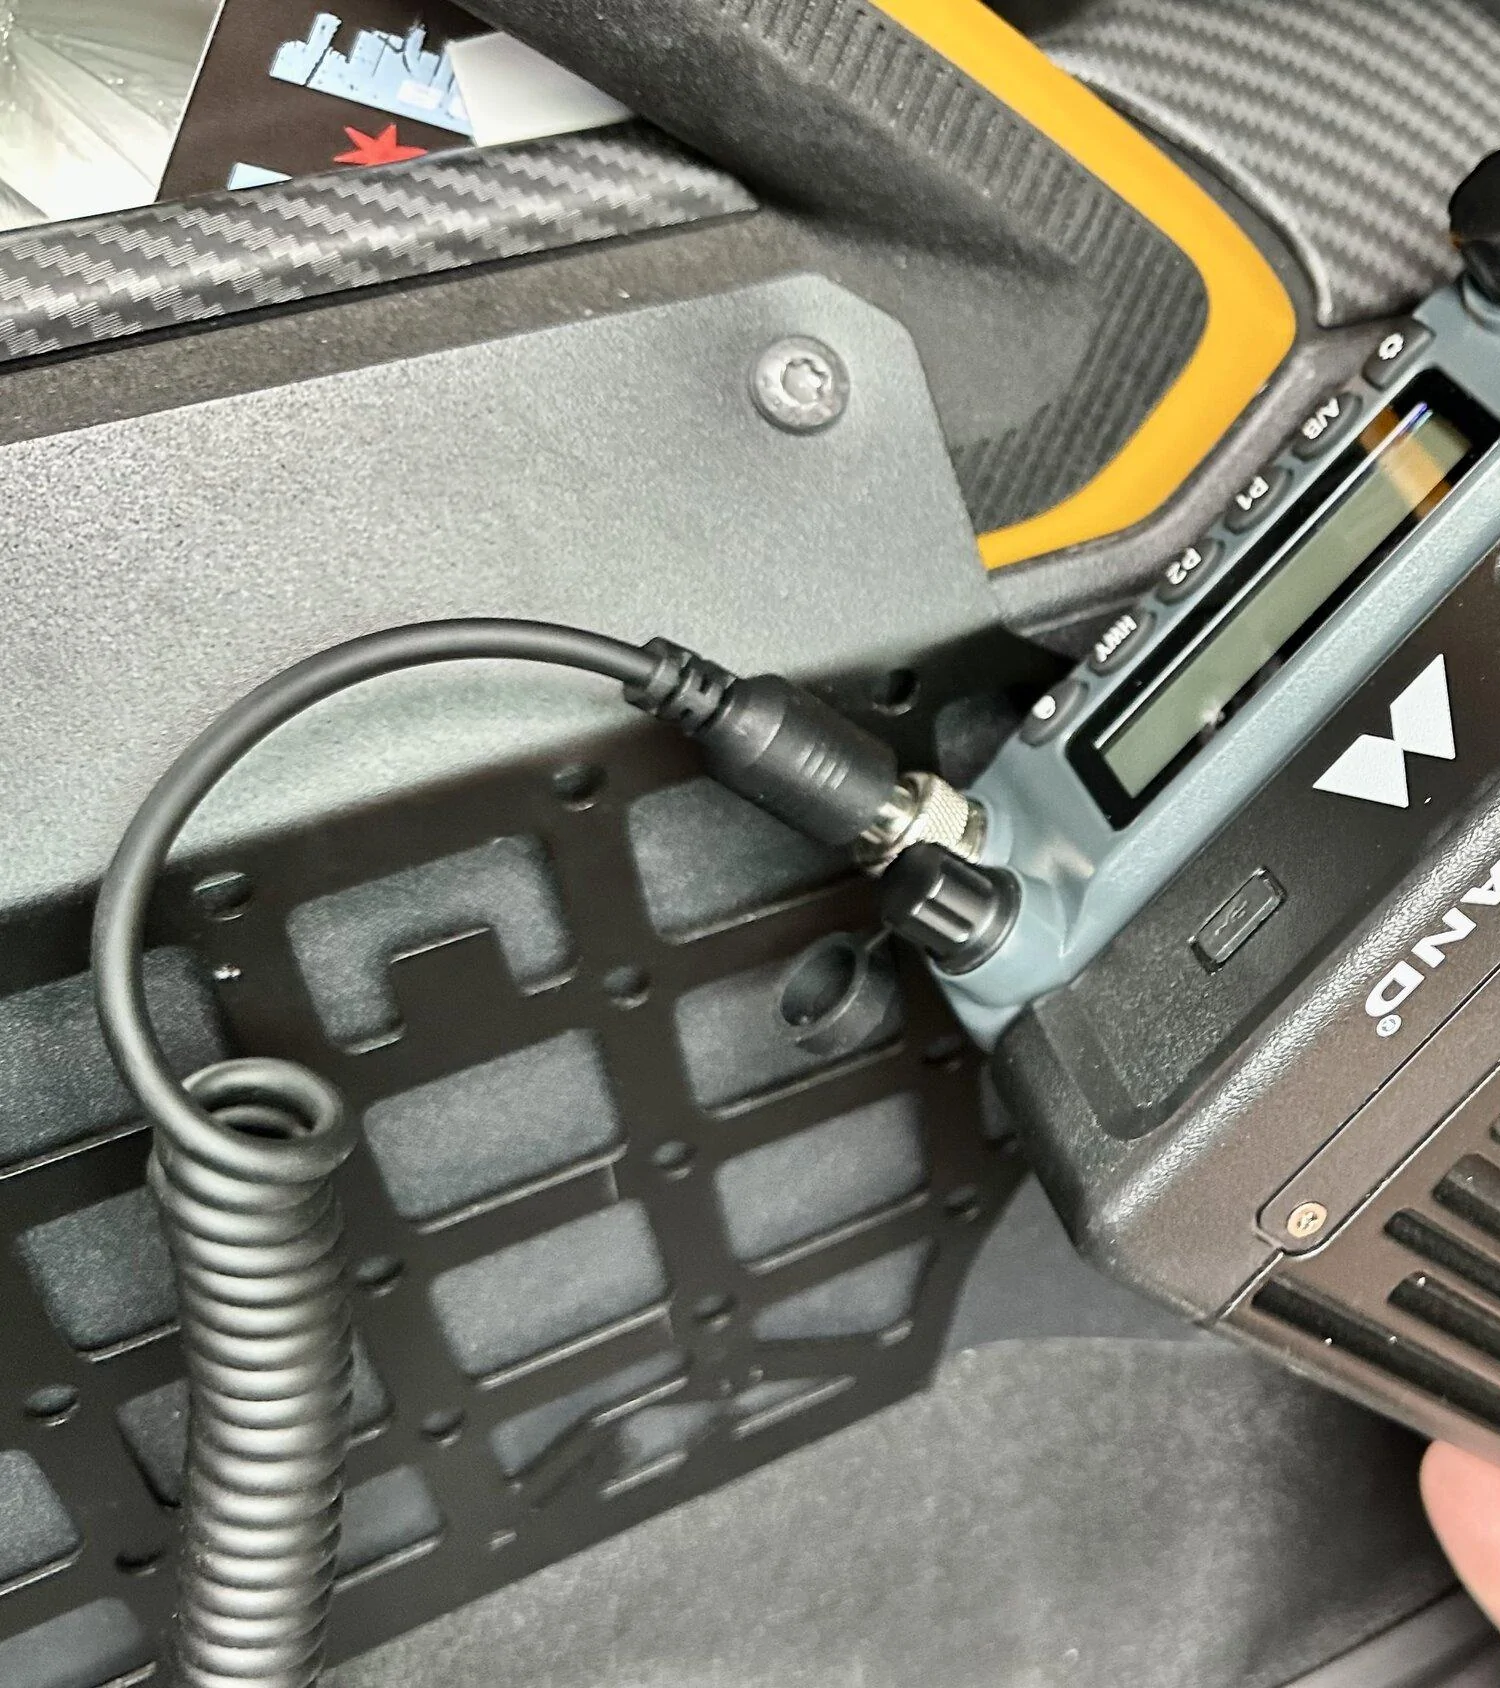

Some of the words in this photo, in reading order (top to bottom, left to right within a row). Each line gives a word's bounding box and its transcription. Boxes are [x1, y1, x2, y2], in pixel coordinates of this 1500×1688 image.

[1302, 397, 1340, 440] A/B
[1235, 475, 1269, 511] P1
[1165, 546, 1202, 584] P2
[1093, 614, 1138, 662] HWY
